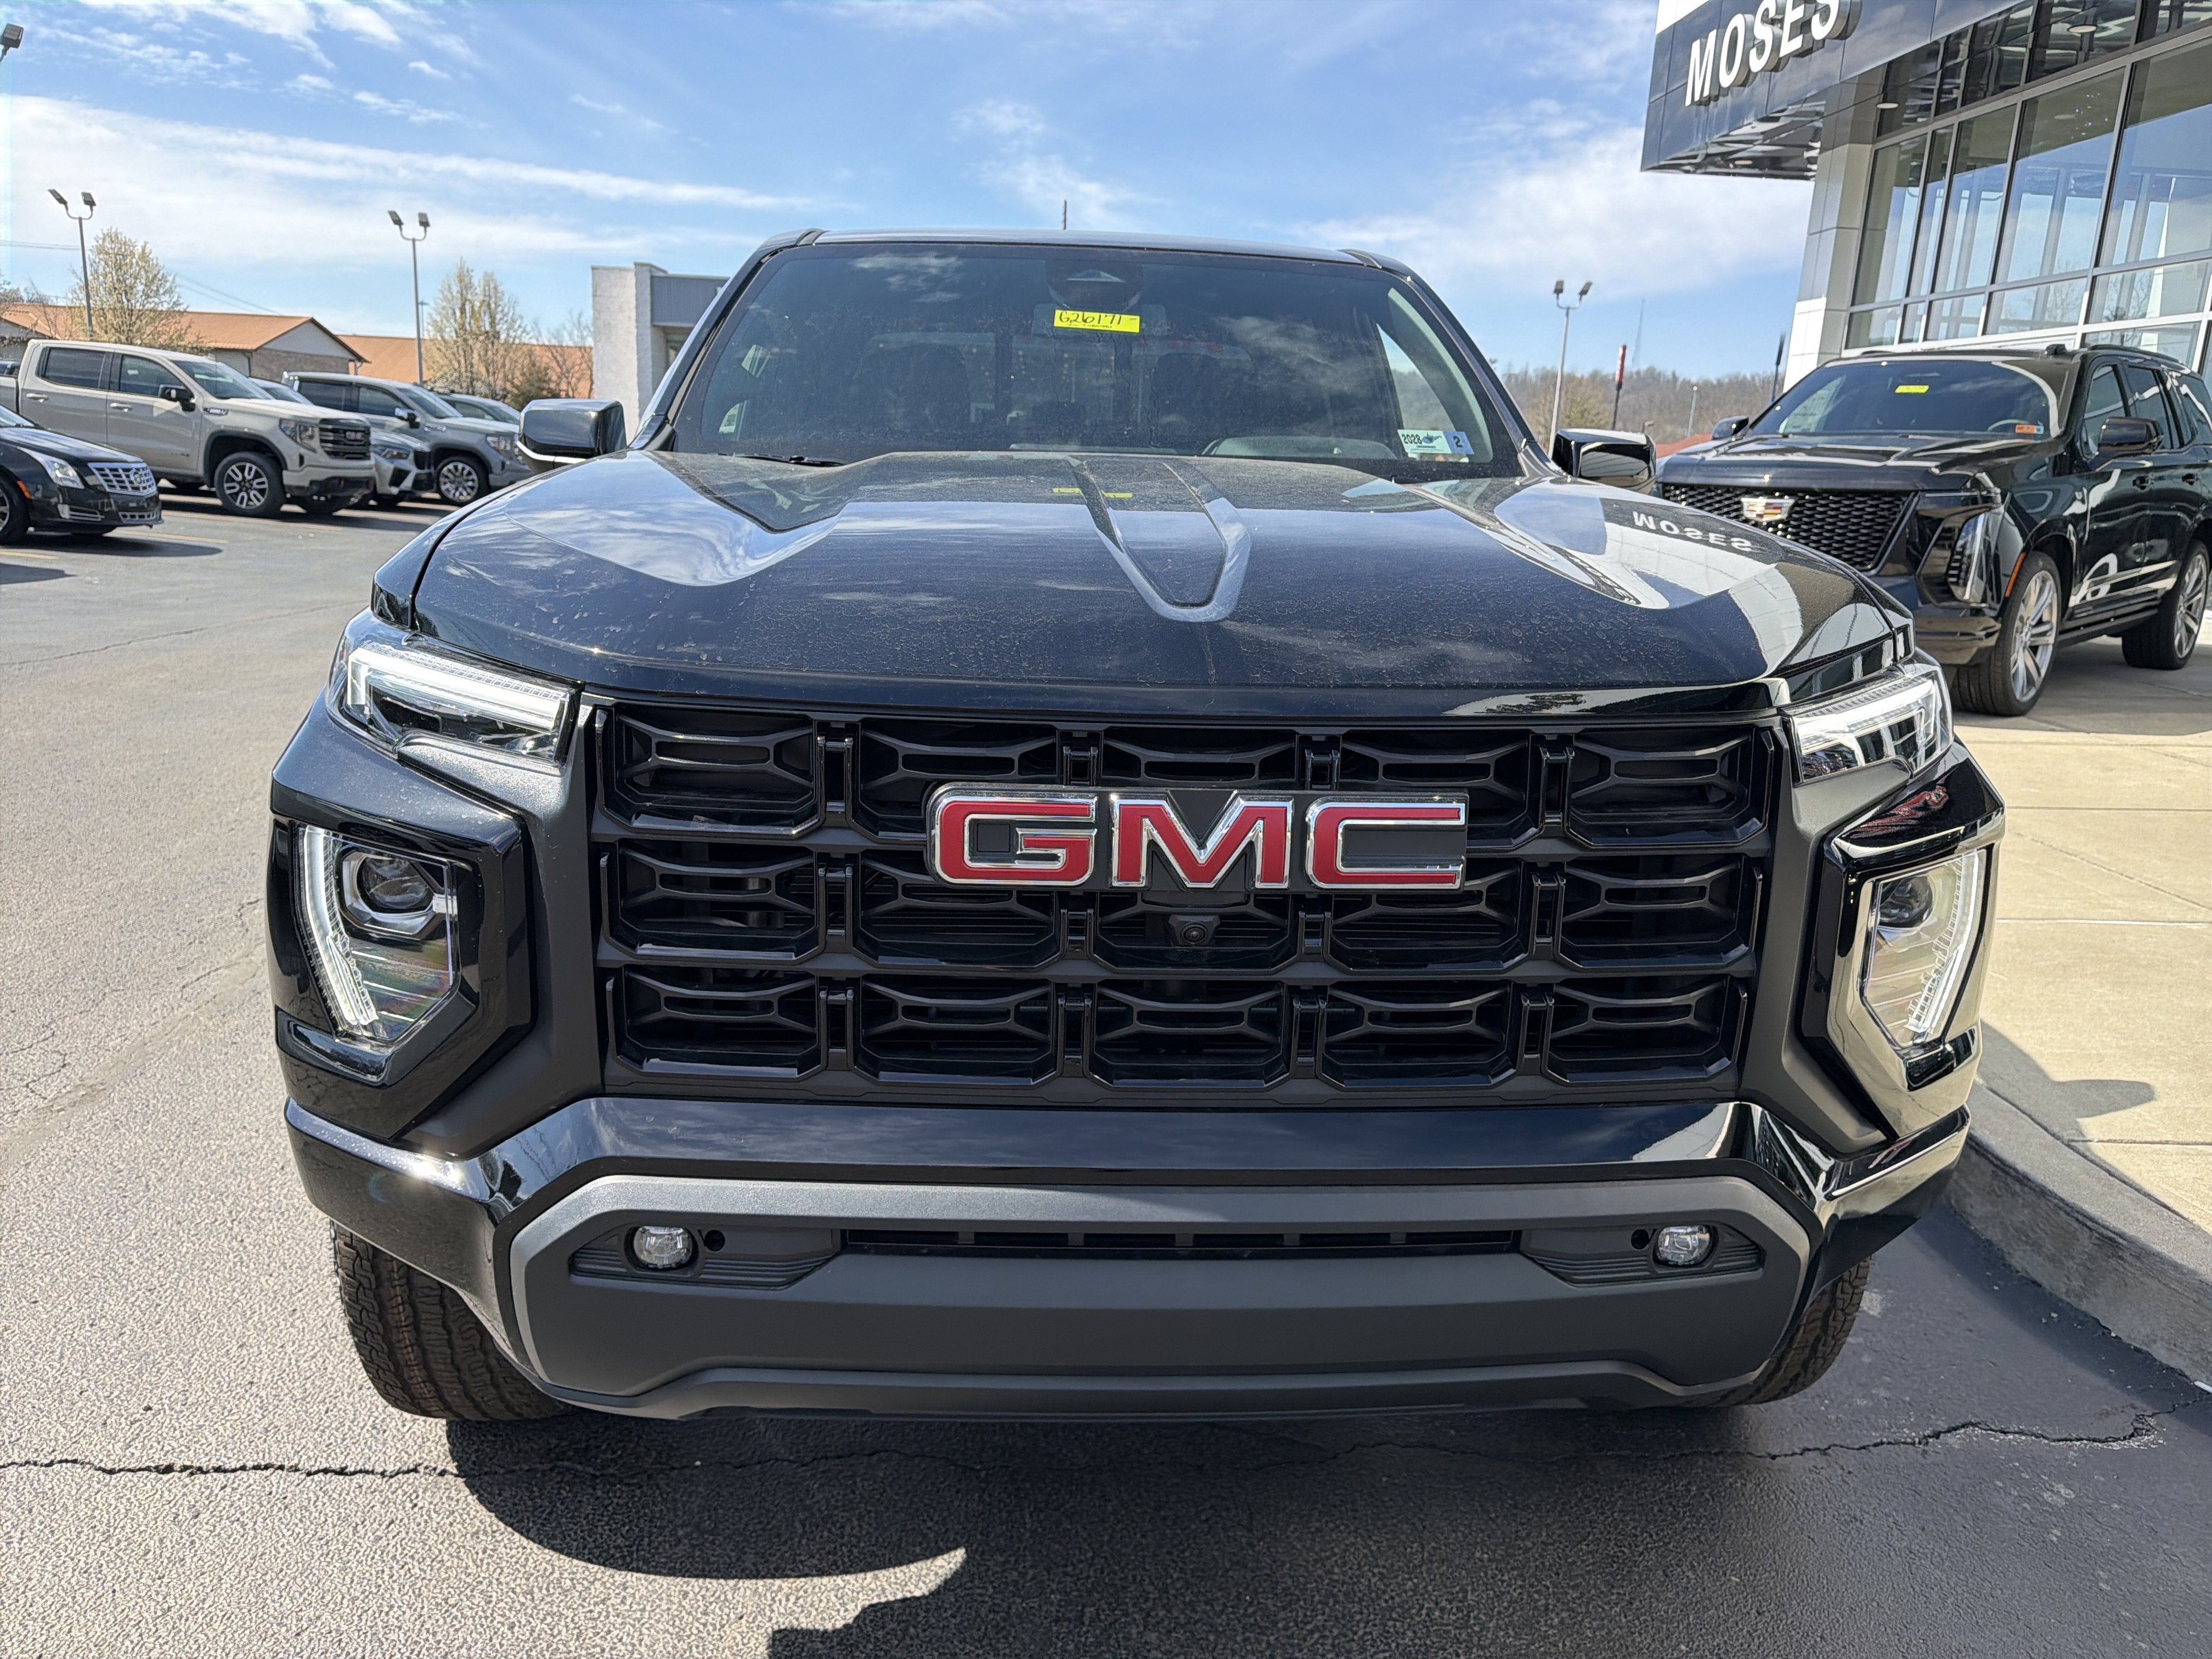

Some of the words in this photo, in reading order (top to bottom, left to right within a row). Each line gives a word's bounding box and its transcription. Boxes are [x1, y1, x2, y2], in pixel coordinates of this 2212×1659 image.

[1685, 0, 1840, 107] MOSES
[1401, 433, 1423, 444] 2028
[1453, 435, 1463, 448] 2
[934, 790, 1466, 890] GMC
